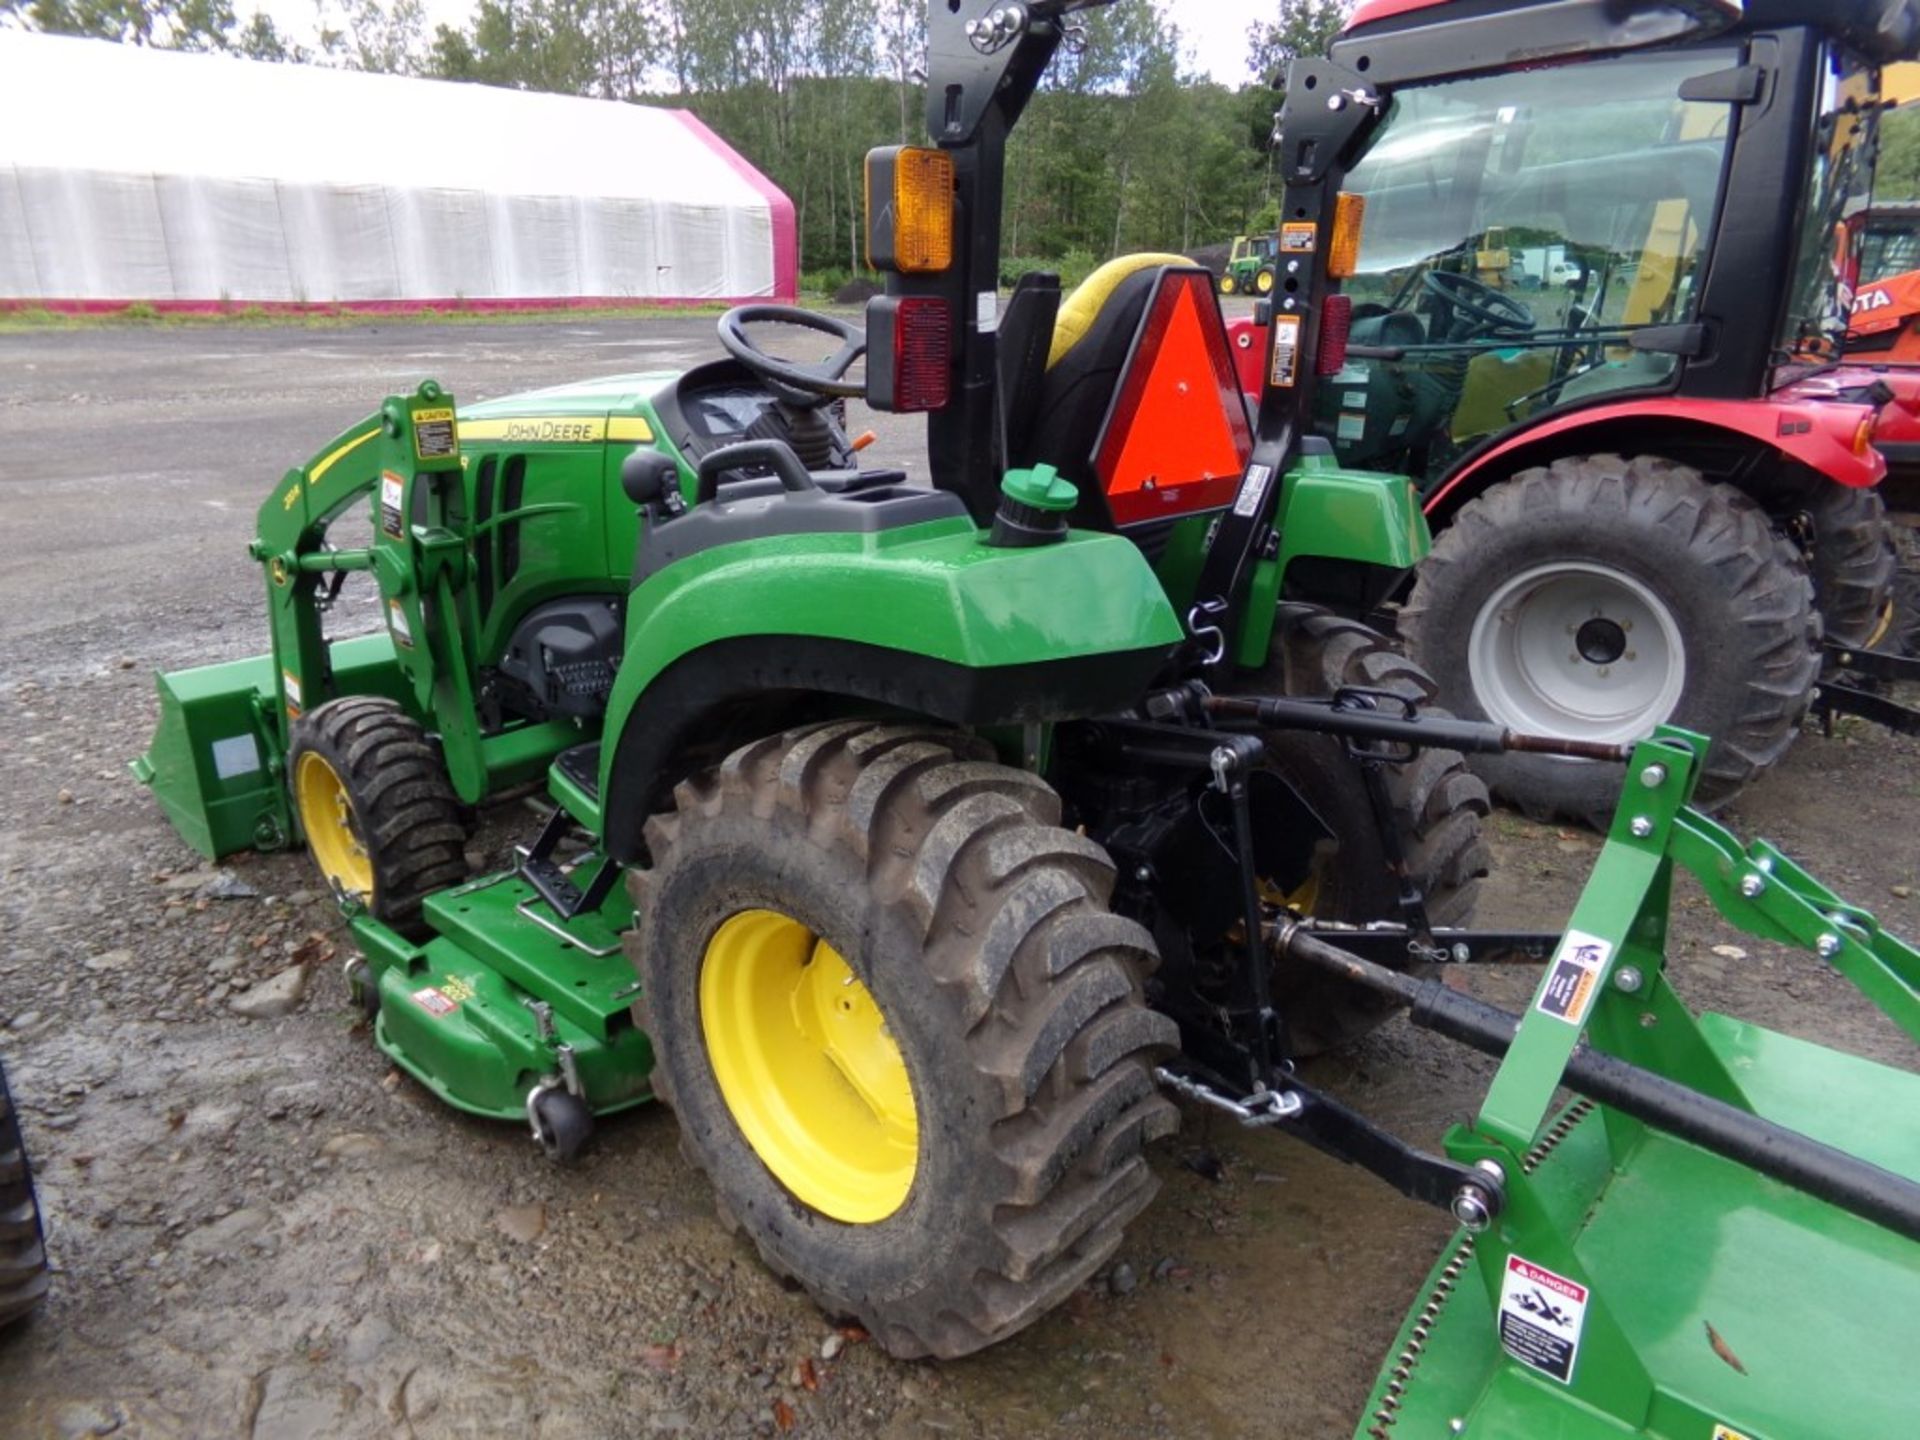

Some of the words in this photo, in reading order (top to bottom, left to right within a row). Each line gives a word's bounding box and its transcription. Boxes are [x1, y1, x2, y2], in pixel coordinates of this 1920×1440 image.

[1851, 289, 1891, 314] TA
[502, 421, 541, 439] JOHN
[541, 421, 593, 440] DEERE
[1529, 1269, 1580, 1300] DANGER
